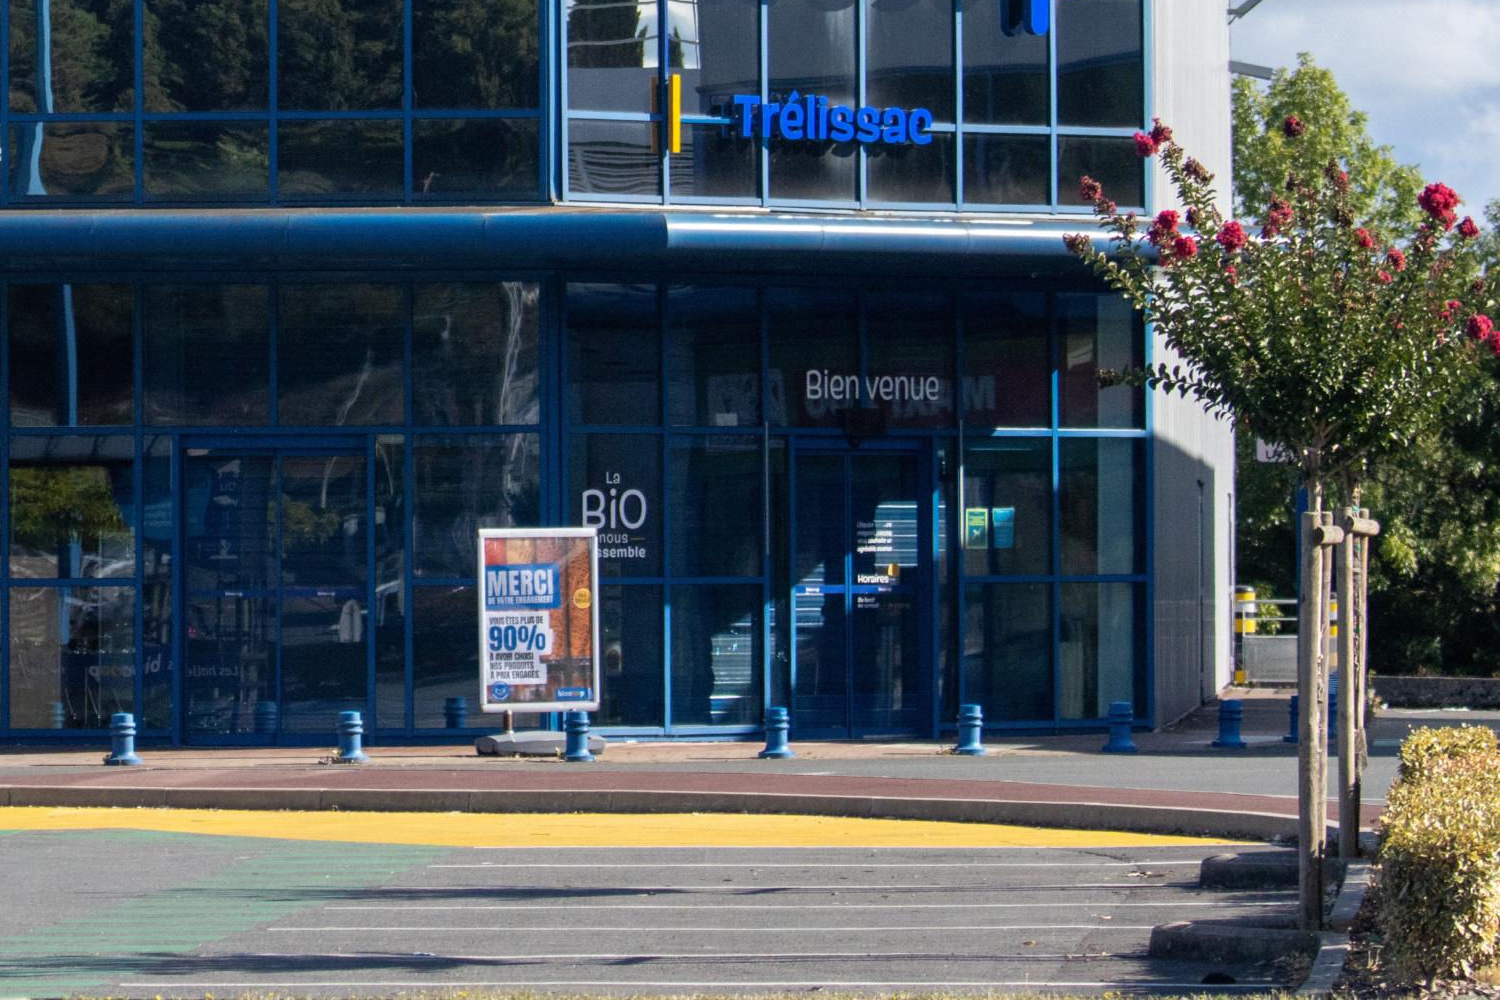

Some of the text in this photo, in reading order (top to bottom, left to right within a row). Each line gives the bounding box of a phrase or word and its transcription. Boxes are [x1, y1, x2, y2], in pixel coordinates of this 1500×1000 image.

[733, 90, 932, 145] Trélissac
[605, 471, 620, 484] La
[598, 533, 628, 544] nous
[597, 546, 646, 558] ssemble
[487, 569, 554, 597] MERCI
[857, 574, 890, 584] Horaires
[489, 616, 505, 625] VOUS
[520, 616, 535, 624] PLUS
[536, 616, 544, 624] DE
[489, 625, 546, 651] 90%
[495, 652, 513, 660] AVOIR
[514, 652, 534, 660] CHOISI
[504, 661, 534, 670] PRODUITS
[496, 671, 511, 679] PRIX
